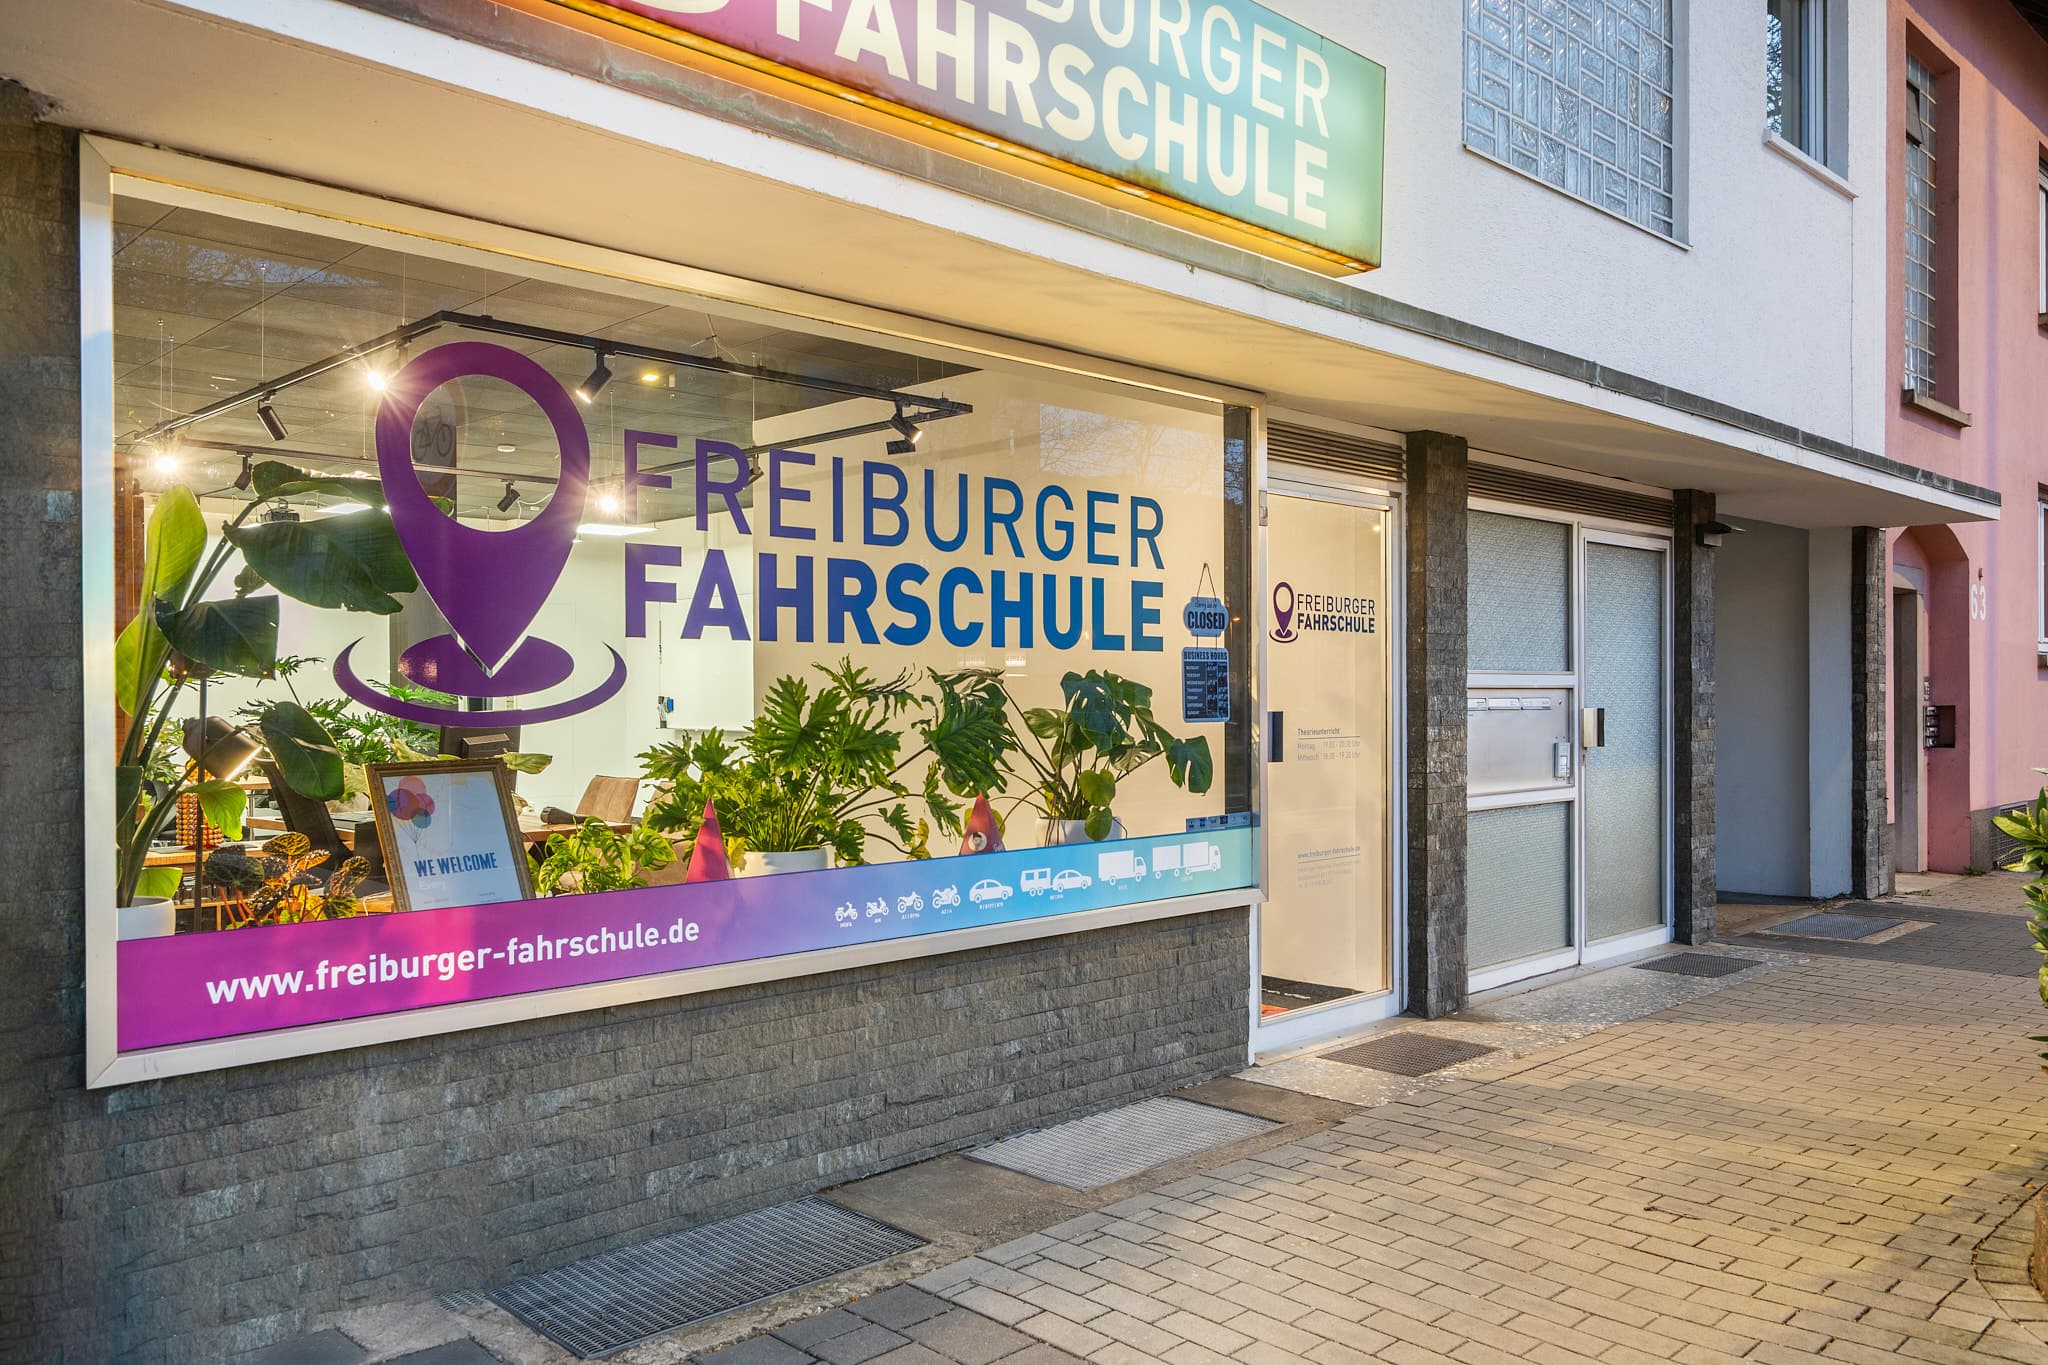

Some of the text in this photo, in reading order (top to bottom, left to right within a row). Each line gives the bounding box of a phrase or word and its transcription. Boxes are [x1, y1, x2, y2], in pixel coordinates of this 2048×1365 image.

[624, 429, 1164, 570] FREIBURGER
[624, 544, 1164, 652] FAHRSCHULE
[1297, 593, 1375, 616] FREIBURGER
[1971, 584, 1987, 621] 63
[1187, 611, 1225, 630] CLOSED
[1297, 613, 1375, 634] FAHRSCHULE
[1184, 651, 1227, 660] BUSINESS HOURS
[414, 852, 499, 878] WE WELCOME
[206, 919, 701, 1005] www.freiburger-fahrschule.de
